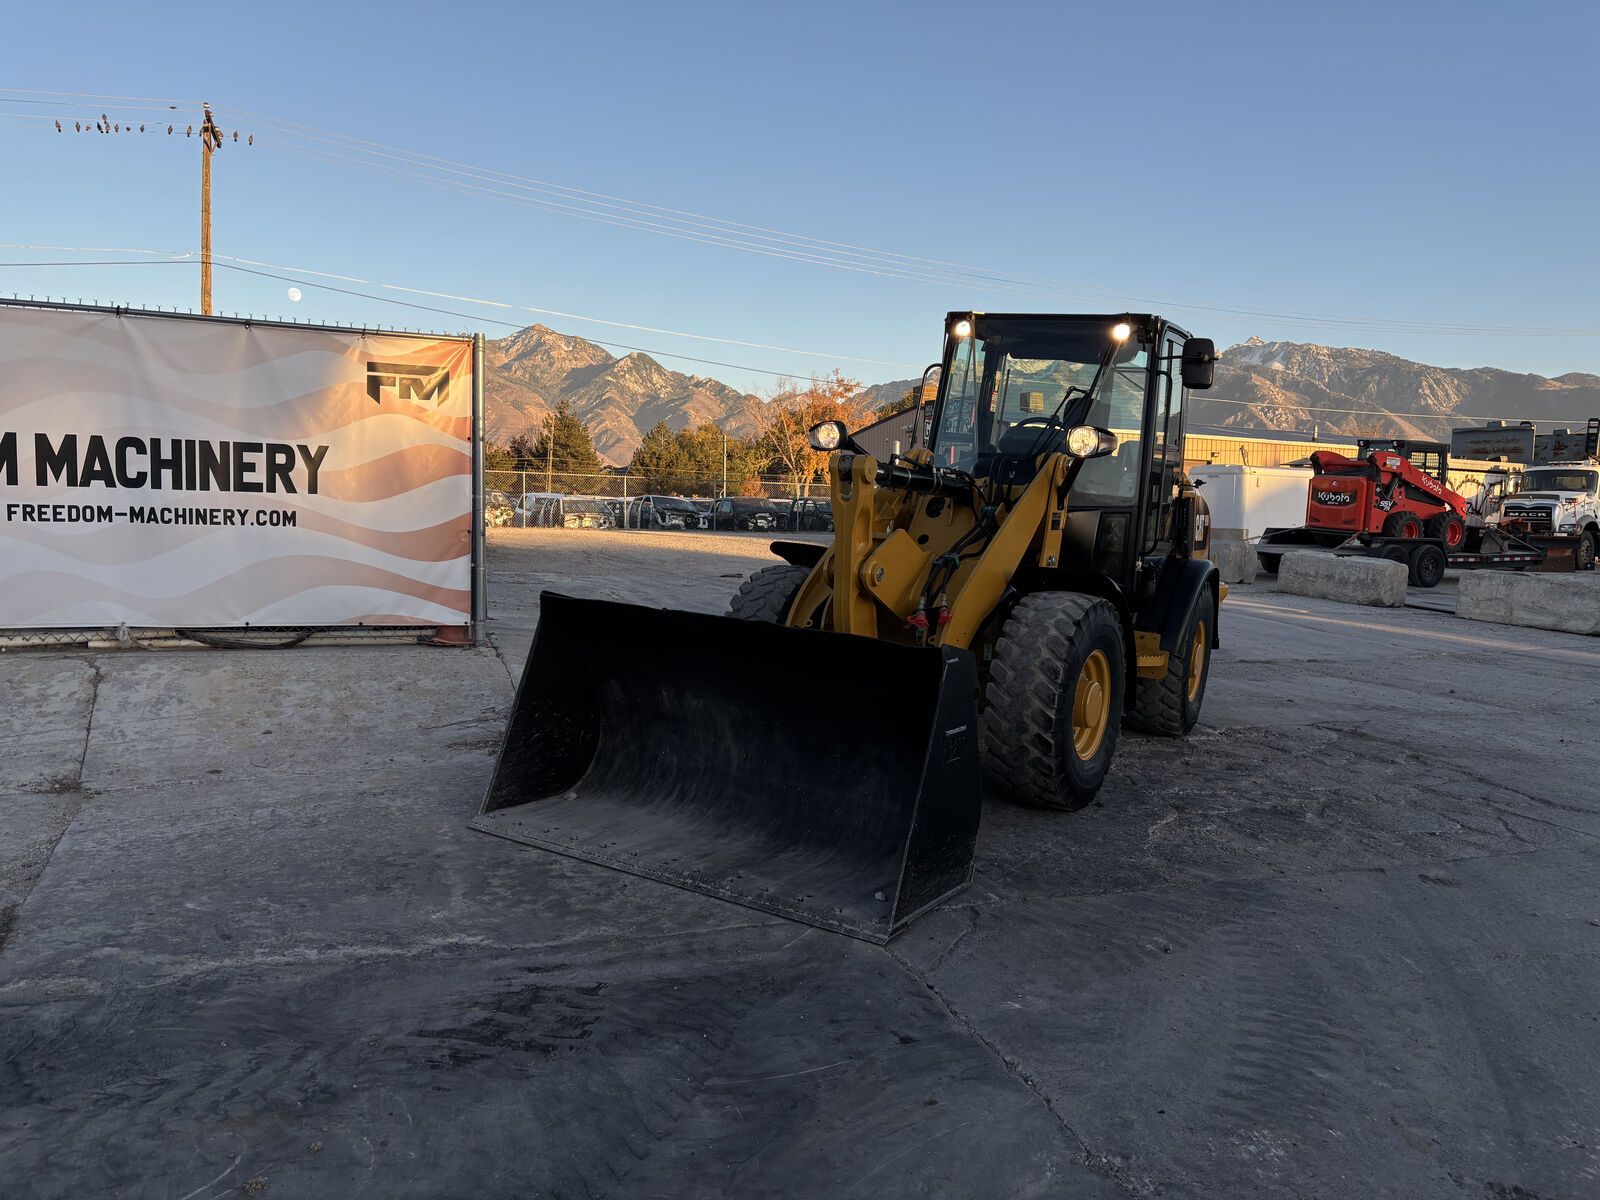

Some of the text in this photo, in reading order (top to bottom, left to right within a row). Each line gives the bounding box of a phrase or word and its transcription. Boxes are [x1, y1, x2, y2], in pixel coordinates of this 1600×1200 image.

[34, 432, 330, 494] MACHINERY
[1421, 475, 1442, 495] Kubota
[1317, 491, 1350, 503] Kubota
[6, 503, 297, 527] FREEDOM-MACHINERY.COM
